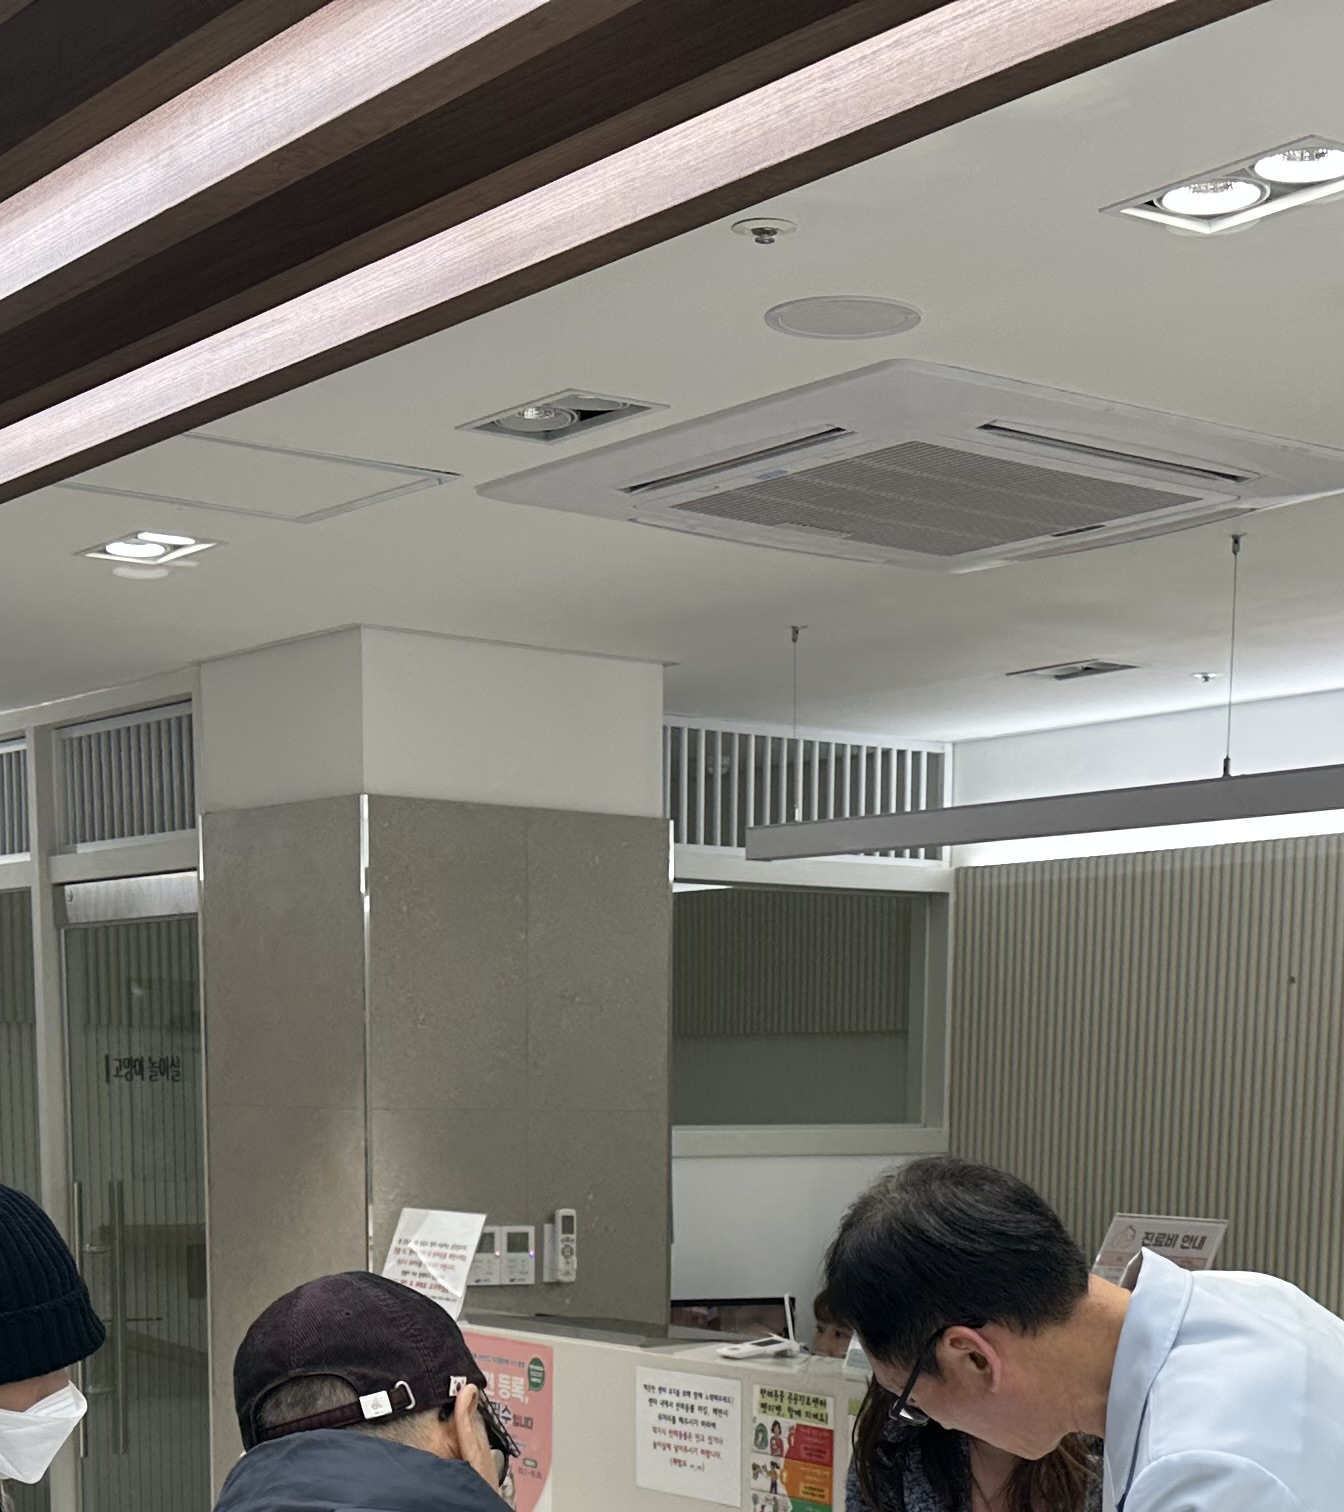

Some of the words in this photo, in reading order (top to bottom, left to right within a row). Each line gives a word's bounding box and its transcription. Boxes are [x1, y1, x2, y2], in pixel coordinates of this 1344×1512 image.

[113, 1055, 144, 1082] 고양이
[148, 1055, 181, 1082] 놀이실
[1141, 1231, 1179, 1248] 진료비
[1180, 1234, 1207, 1250] 안내
